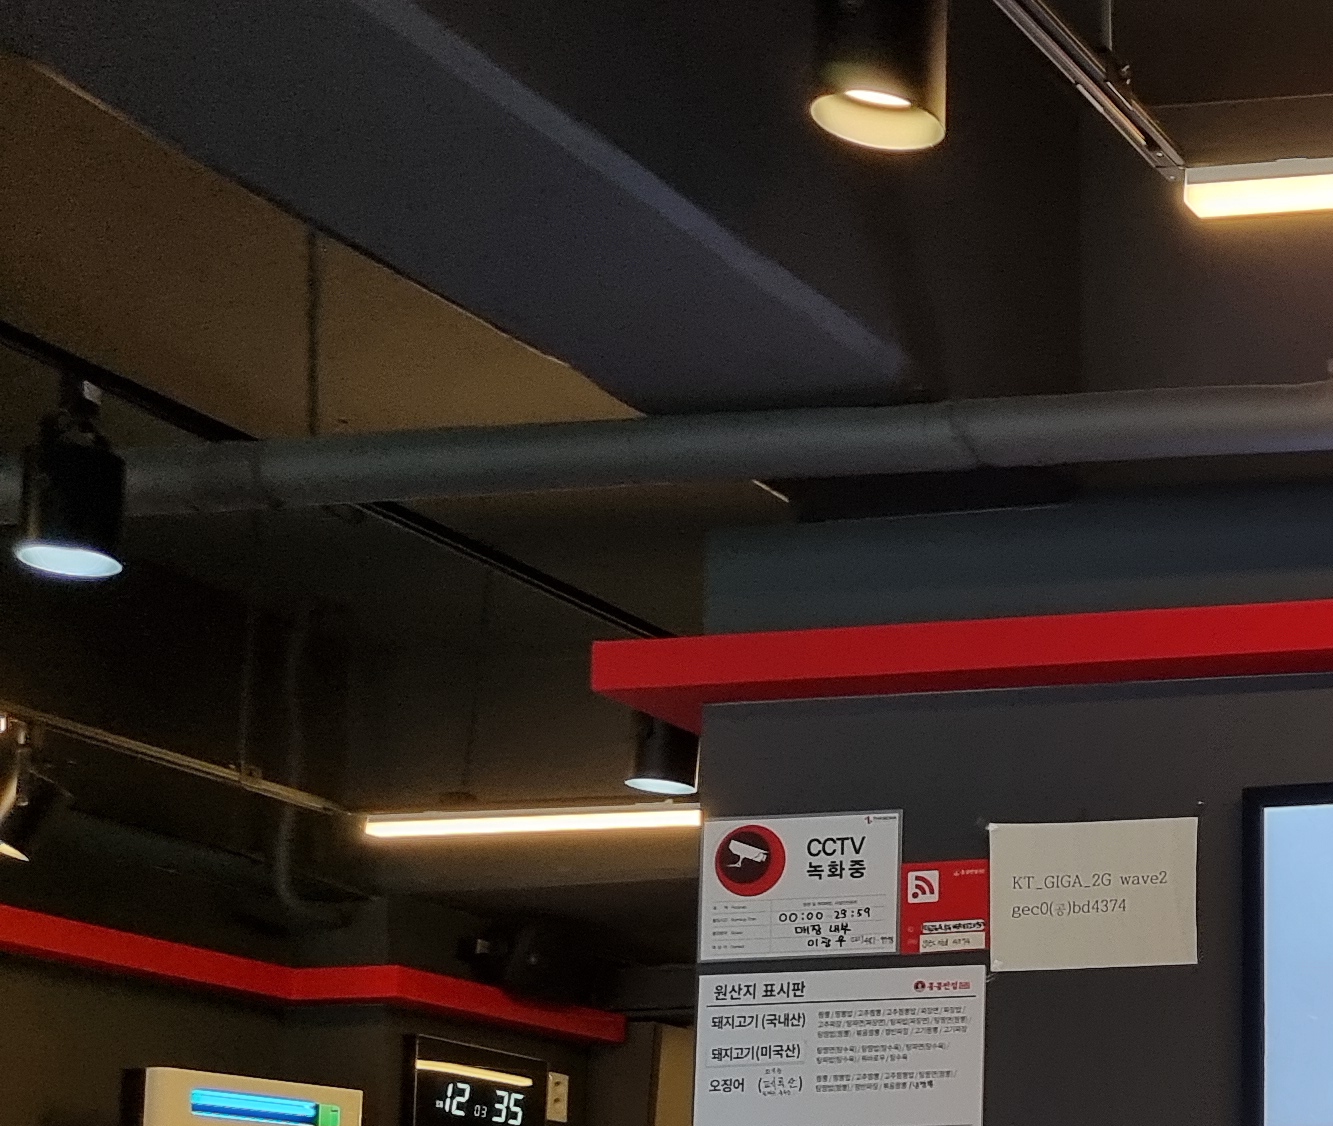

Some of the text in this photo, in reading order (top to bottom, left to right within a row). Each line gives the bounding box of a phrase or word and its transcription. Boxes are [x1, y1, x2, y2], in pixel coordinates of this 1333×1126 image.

[807, 836, 866, 857] CCTV
[1012, 871, 1168, 890] KT_GIGA_2G wave2
[795, 923, 851, 935] 매장 내부
[714, 981, 805, 1000] 원산지 표시판
[711, 1014, 758, 1029] 돼지고기
[761, 1012, 806, 1029] (국내산)
[709, 1078, 745, 1092] 오징어
[445, 1082, 471, 1116] 12
[492, 1089, 525, 1126] 35
